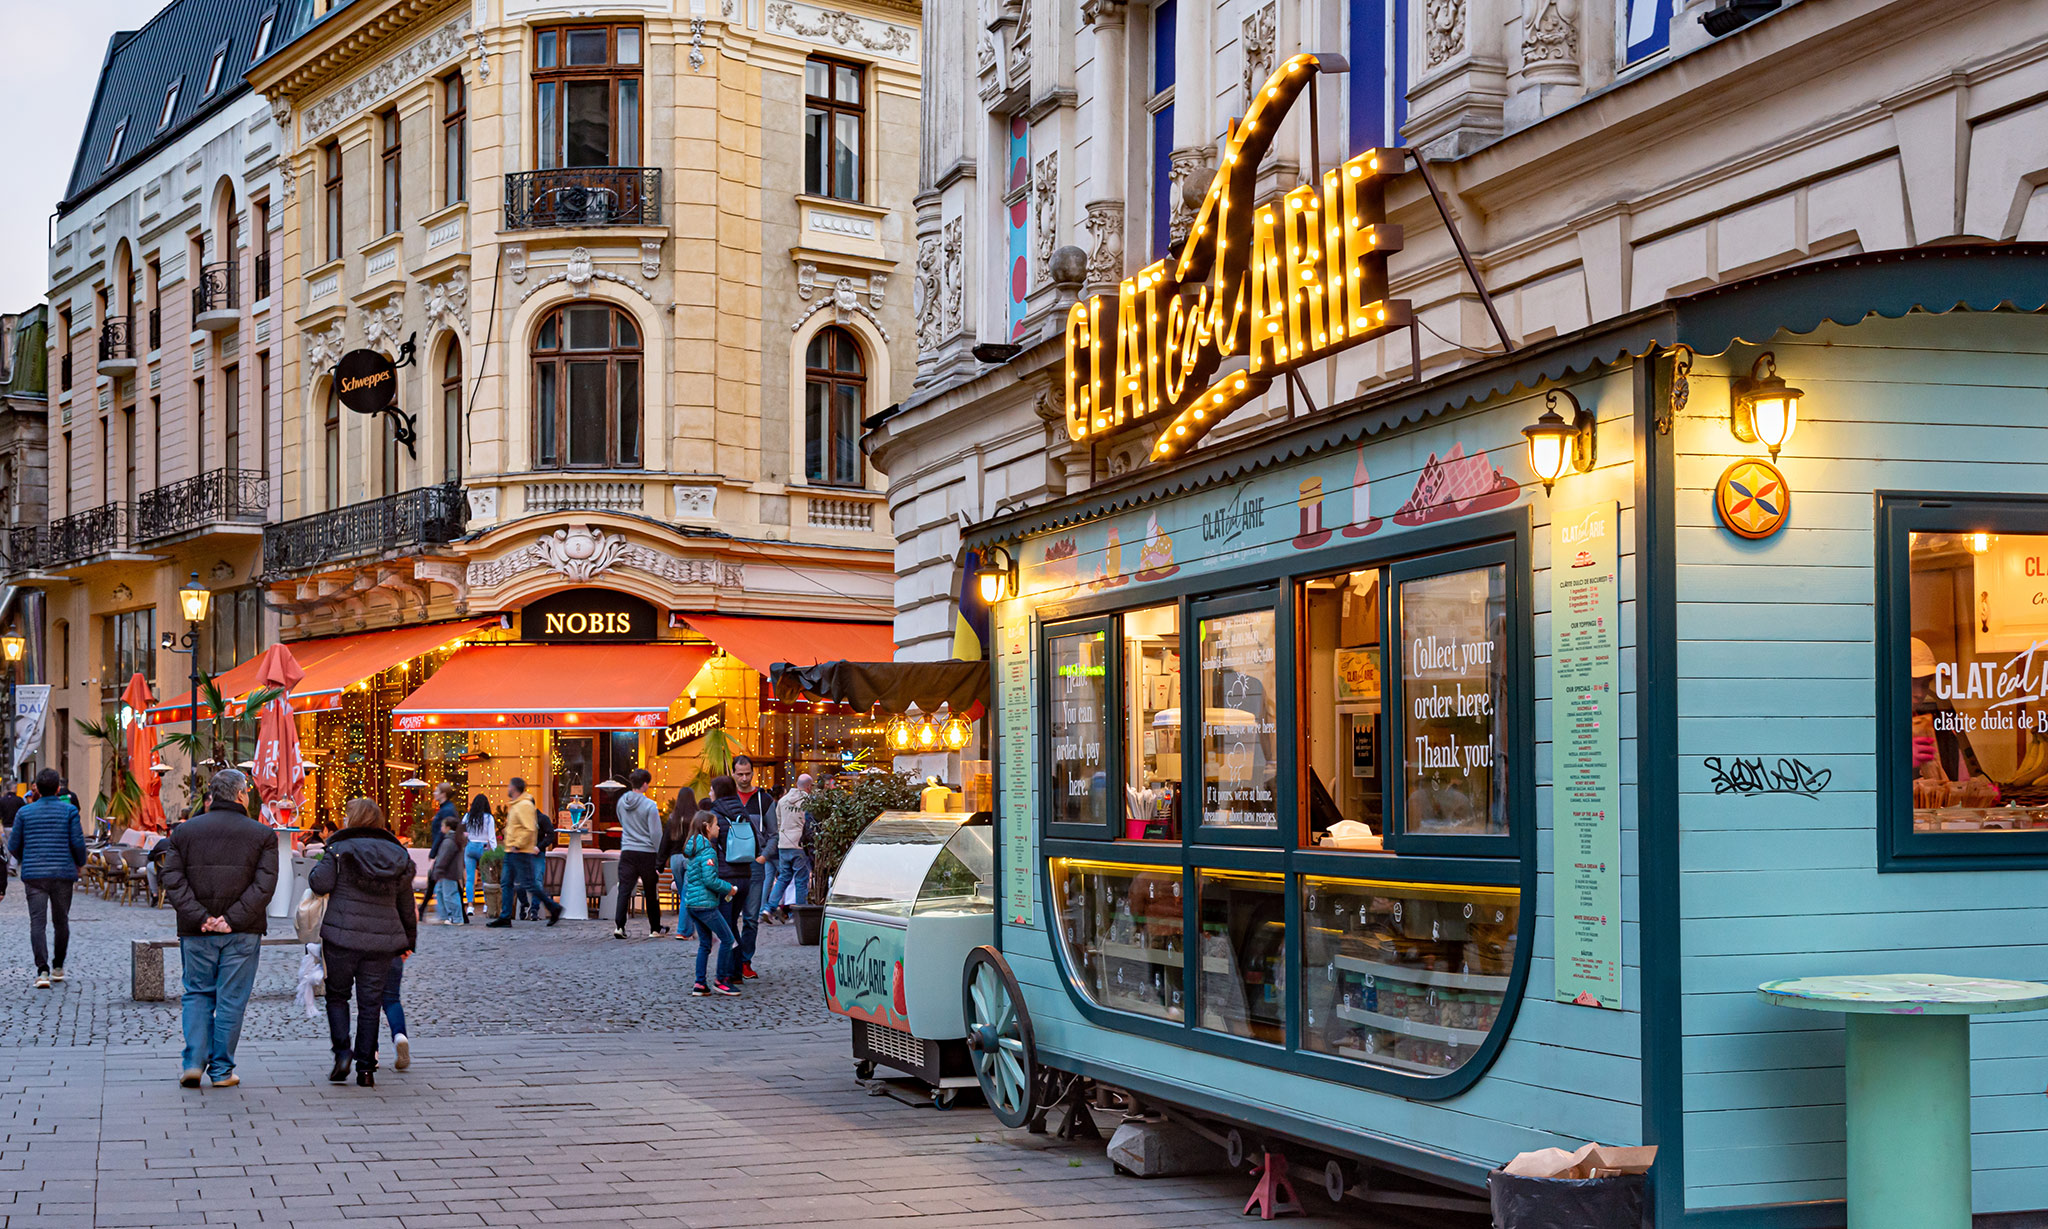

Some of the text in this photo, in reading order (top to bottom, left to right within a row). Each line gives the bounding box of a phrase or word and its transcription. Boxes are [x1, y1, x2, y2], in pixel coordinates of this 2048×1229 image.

[341, 370, 391, 393] Schweppes
[2025, 556, 2048, 577] CL
[545, 612, 631, 634] NOBIS
[1413, 635, 1494, 678] Collect your
[1414, 683, 1494, 720] order here.
[512, 714, 554, 724] NOBIS
[1062, 701, 1093, 729] You can
[1981, 710, 2014, 731] dulci
[2017, 709, 2033, 729] de
[664, 713, 718, 745] Schweppes
[1056, 735, 1100, 766] order & pay
[1416, 734, 1460, 775] Thank
[1463, 734, 1494, 776] you!
[1069, 771, 1088, 796] here.
